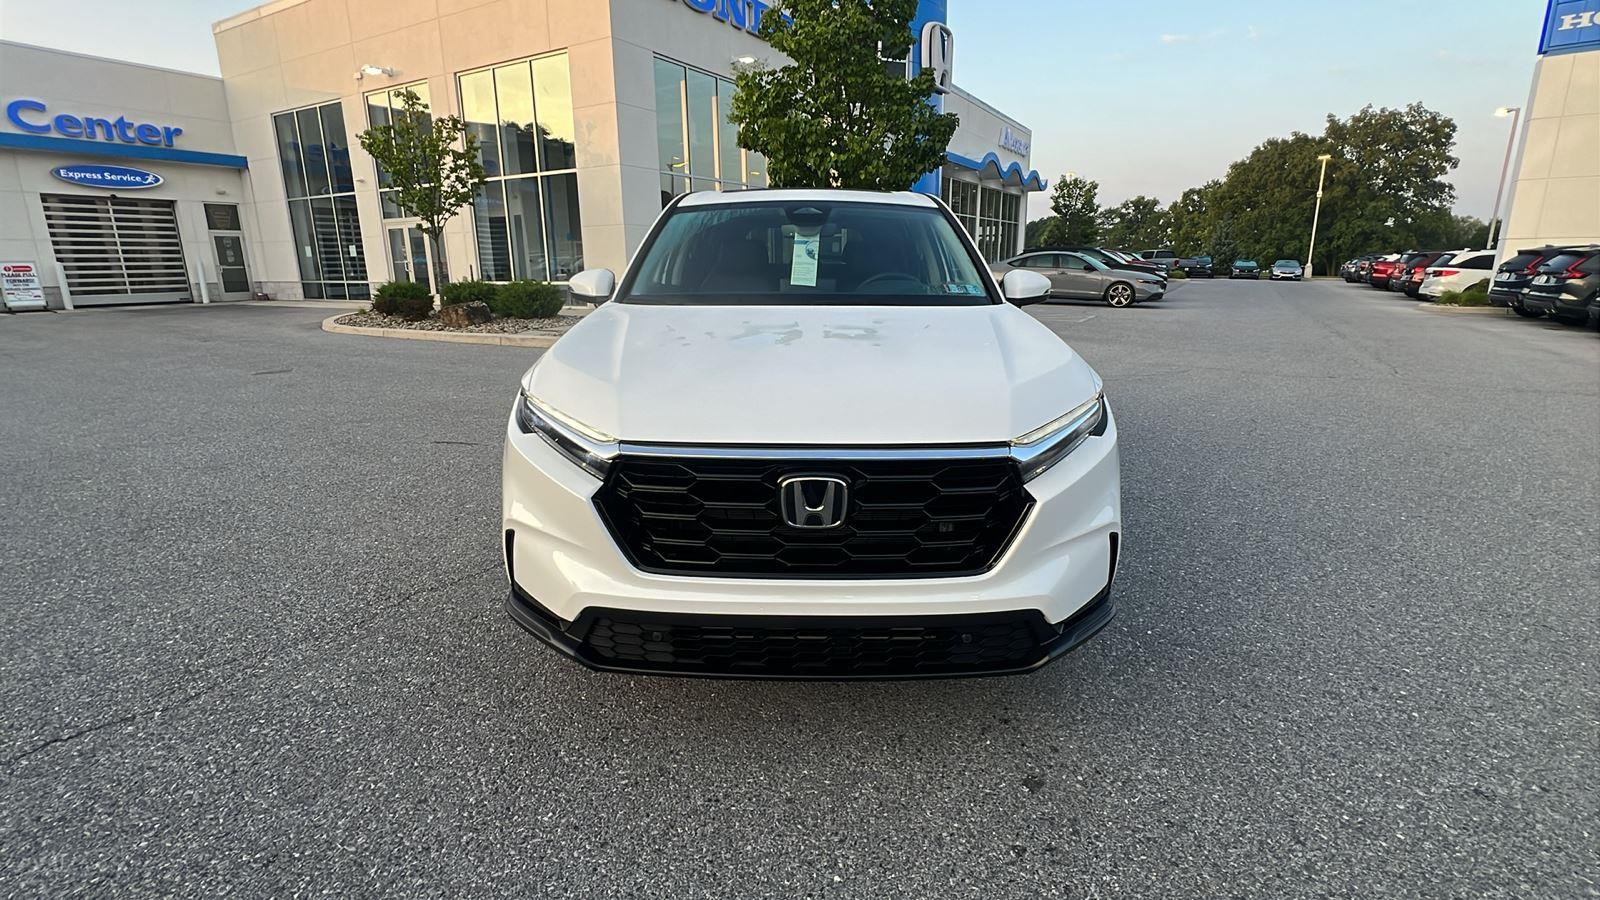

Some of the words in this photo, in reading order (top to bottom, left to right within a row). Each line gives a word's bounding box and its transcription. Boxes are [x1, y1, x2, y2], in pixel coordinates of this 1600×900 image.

[1558, 11, 1600, 31] H
[6, 99, 184, 147] Center
[60, 169, 102, 180] Express
[103, 172, 142, 182] Service
